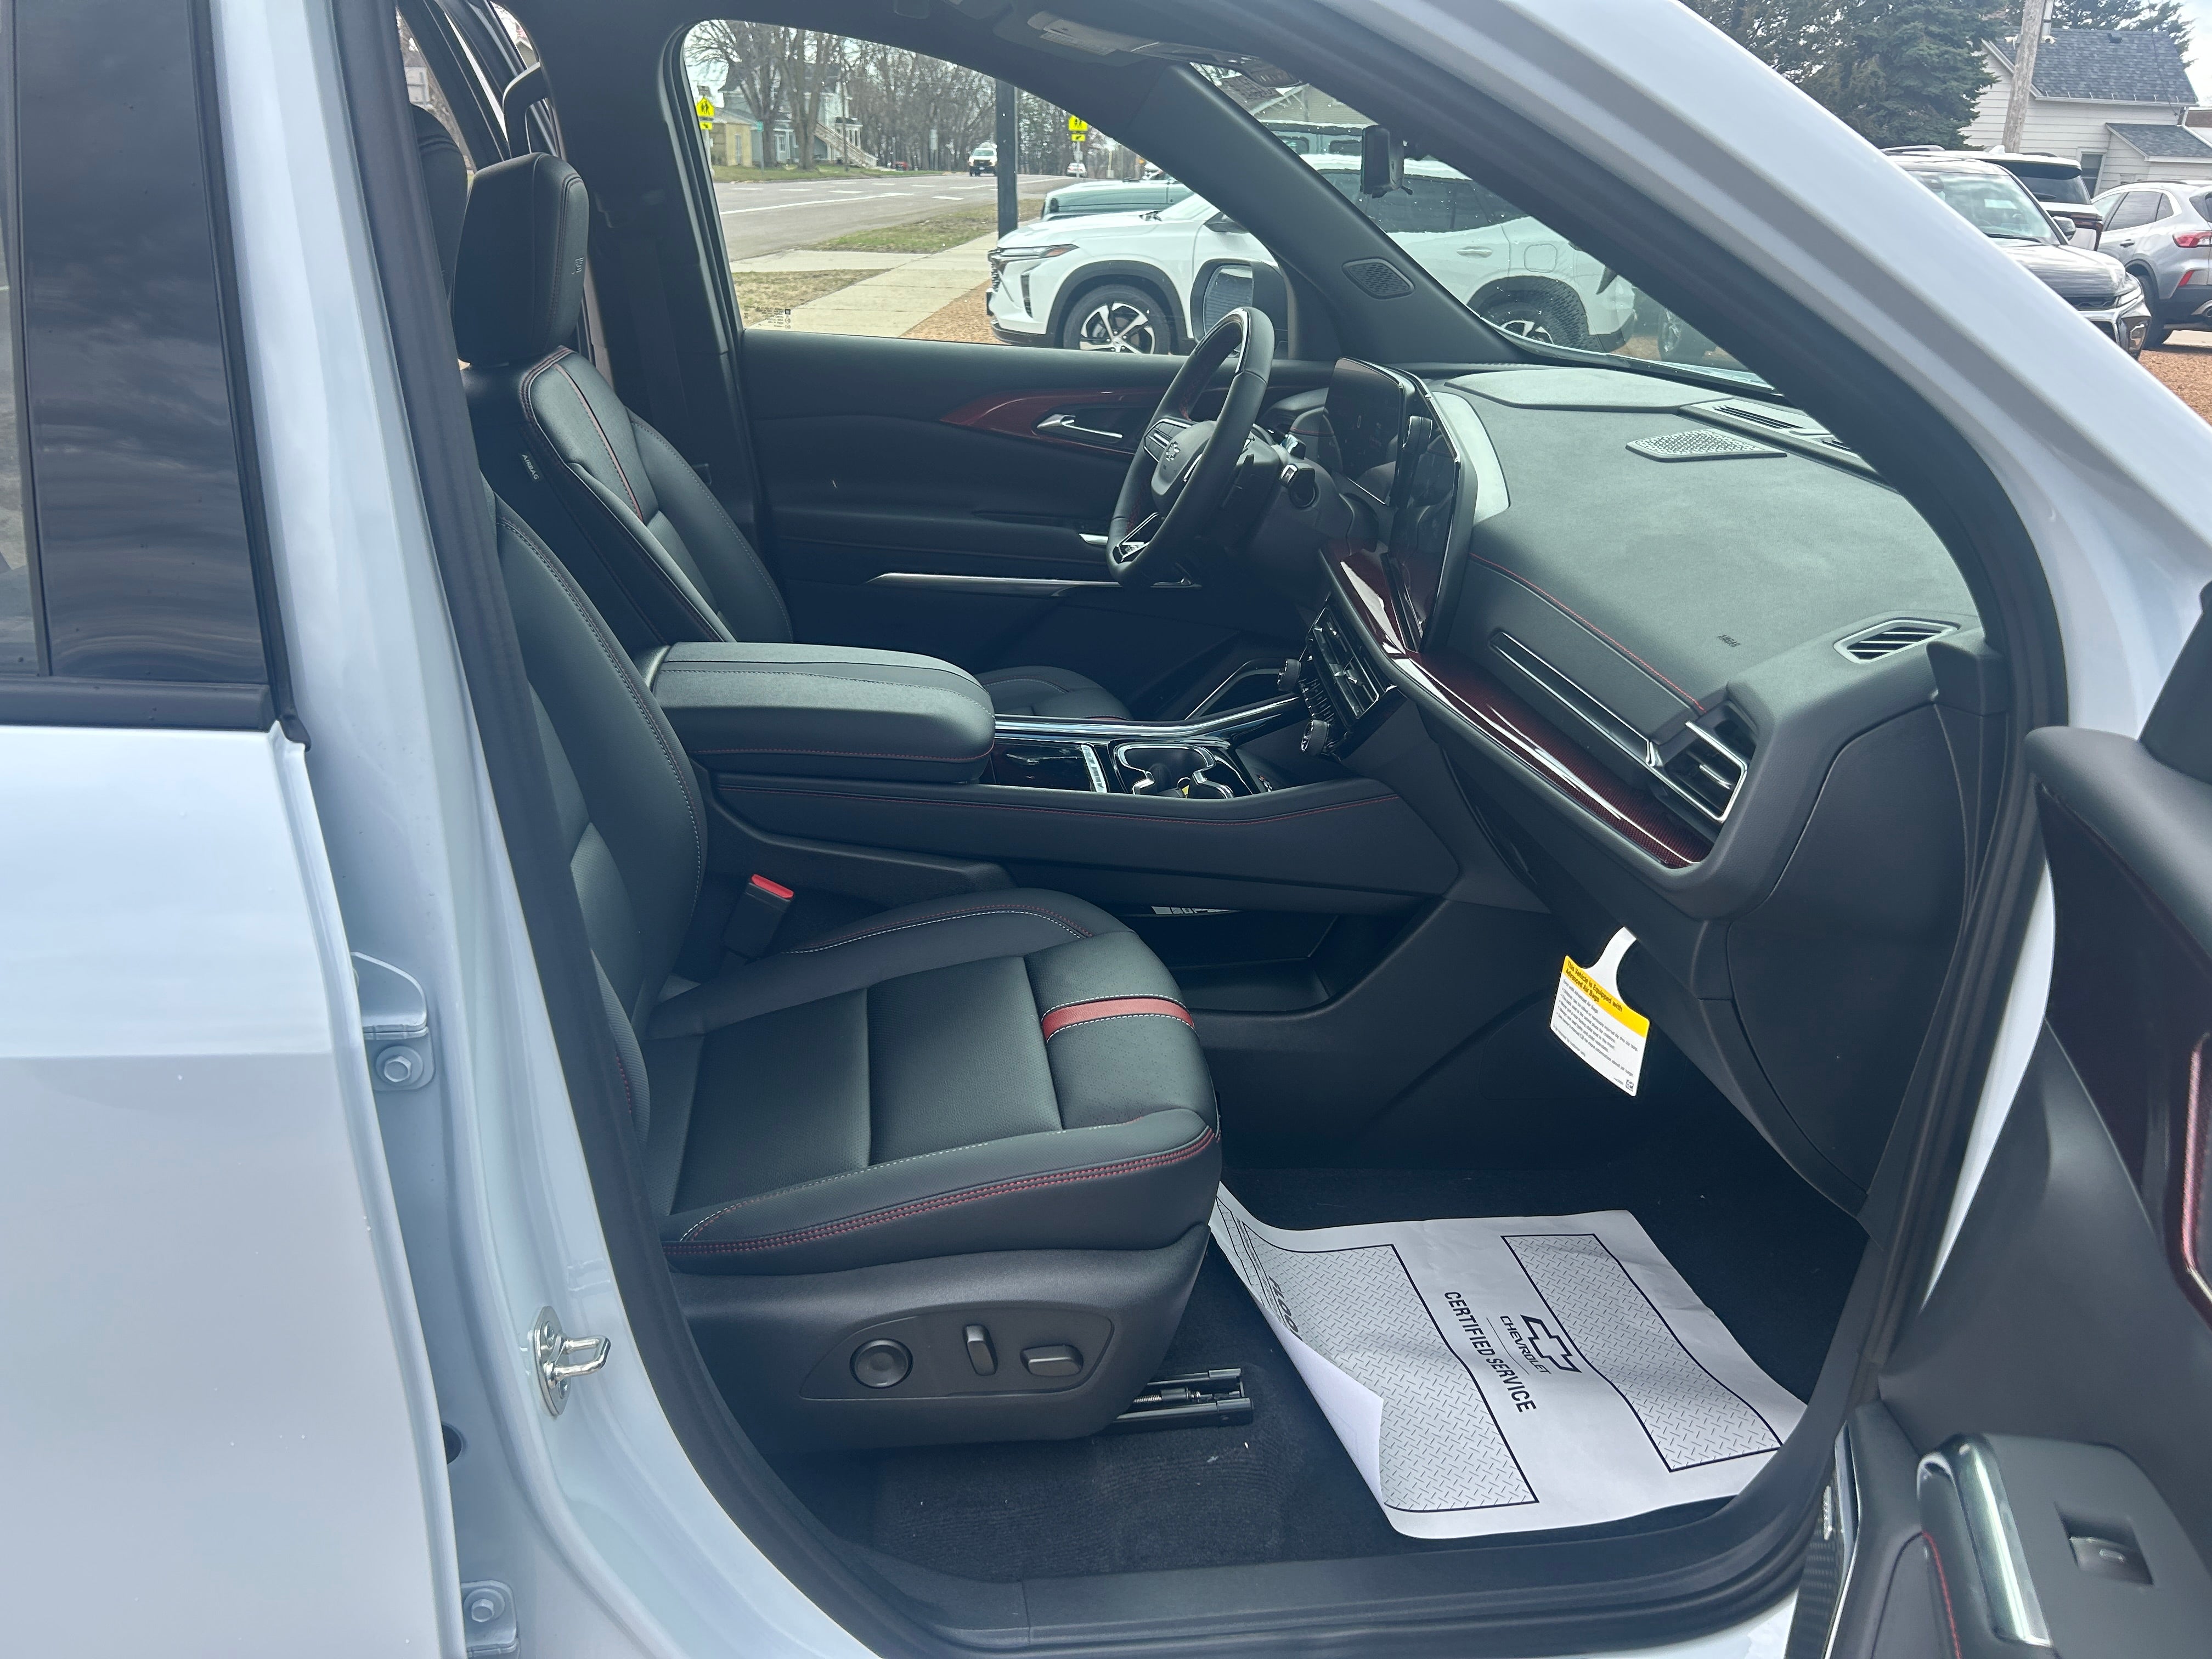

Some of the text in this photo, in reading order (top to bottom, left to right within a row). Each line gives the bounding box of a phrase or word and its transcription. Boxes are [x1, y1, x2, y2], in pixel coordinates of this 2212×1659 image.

[522, 455, 539, 479] AIRBAG
[1717, 635, 1741, 647] AIRBAG
[1444, 1291, 1537, 1413] CERTIFIED SERVICE
[1500, 1316, 1551, 1374] CHEVROLET
